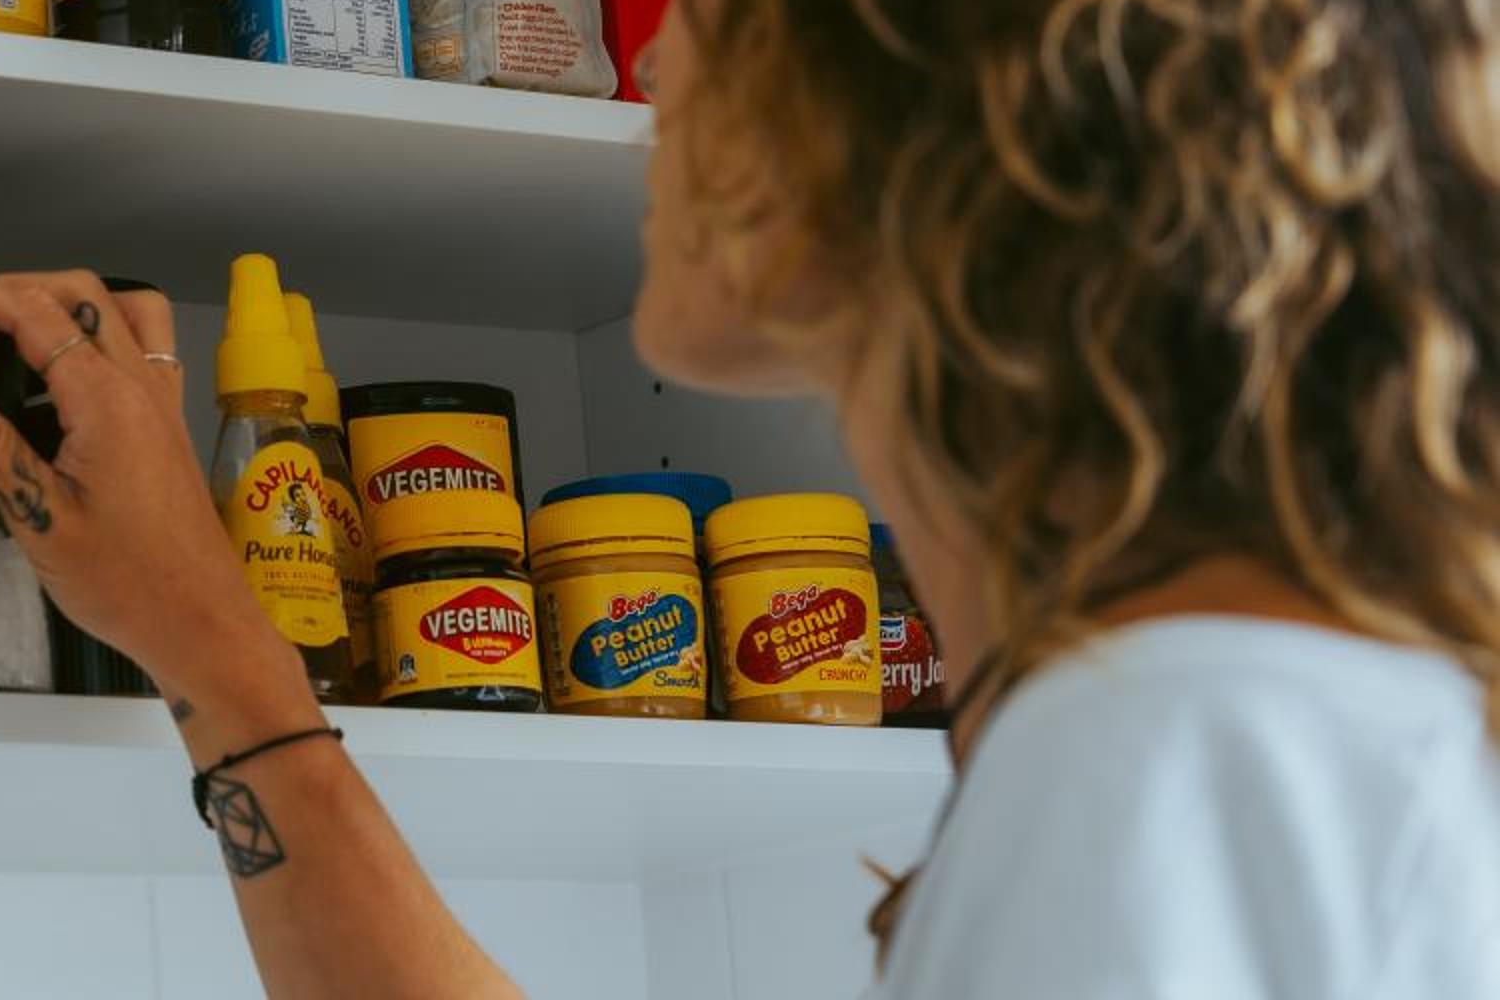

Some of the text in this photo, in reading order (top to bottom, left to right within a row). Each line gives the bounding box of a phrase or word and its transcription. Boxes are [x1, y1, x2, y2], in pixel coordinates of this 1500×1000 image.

[375, 467, 499, 500] VEGEMITE
[244, 540, 293, 564] Pure
[611, 591, 659, 622] Bega
[770, 585, 819, 619] Bega
[426, 606, 532, 641] VEGEMITE
[591, 603, 682, 657] Peanut
[754, 597, 848, 652] Peanut
[613, 633, 676, 668] Butter
[775, 626, 840, 664] Butter
[819, 667, 868, 682] CRUNCHY
[882, 663, 921, 697] erry
